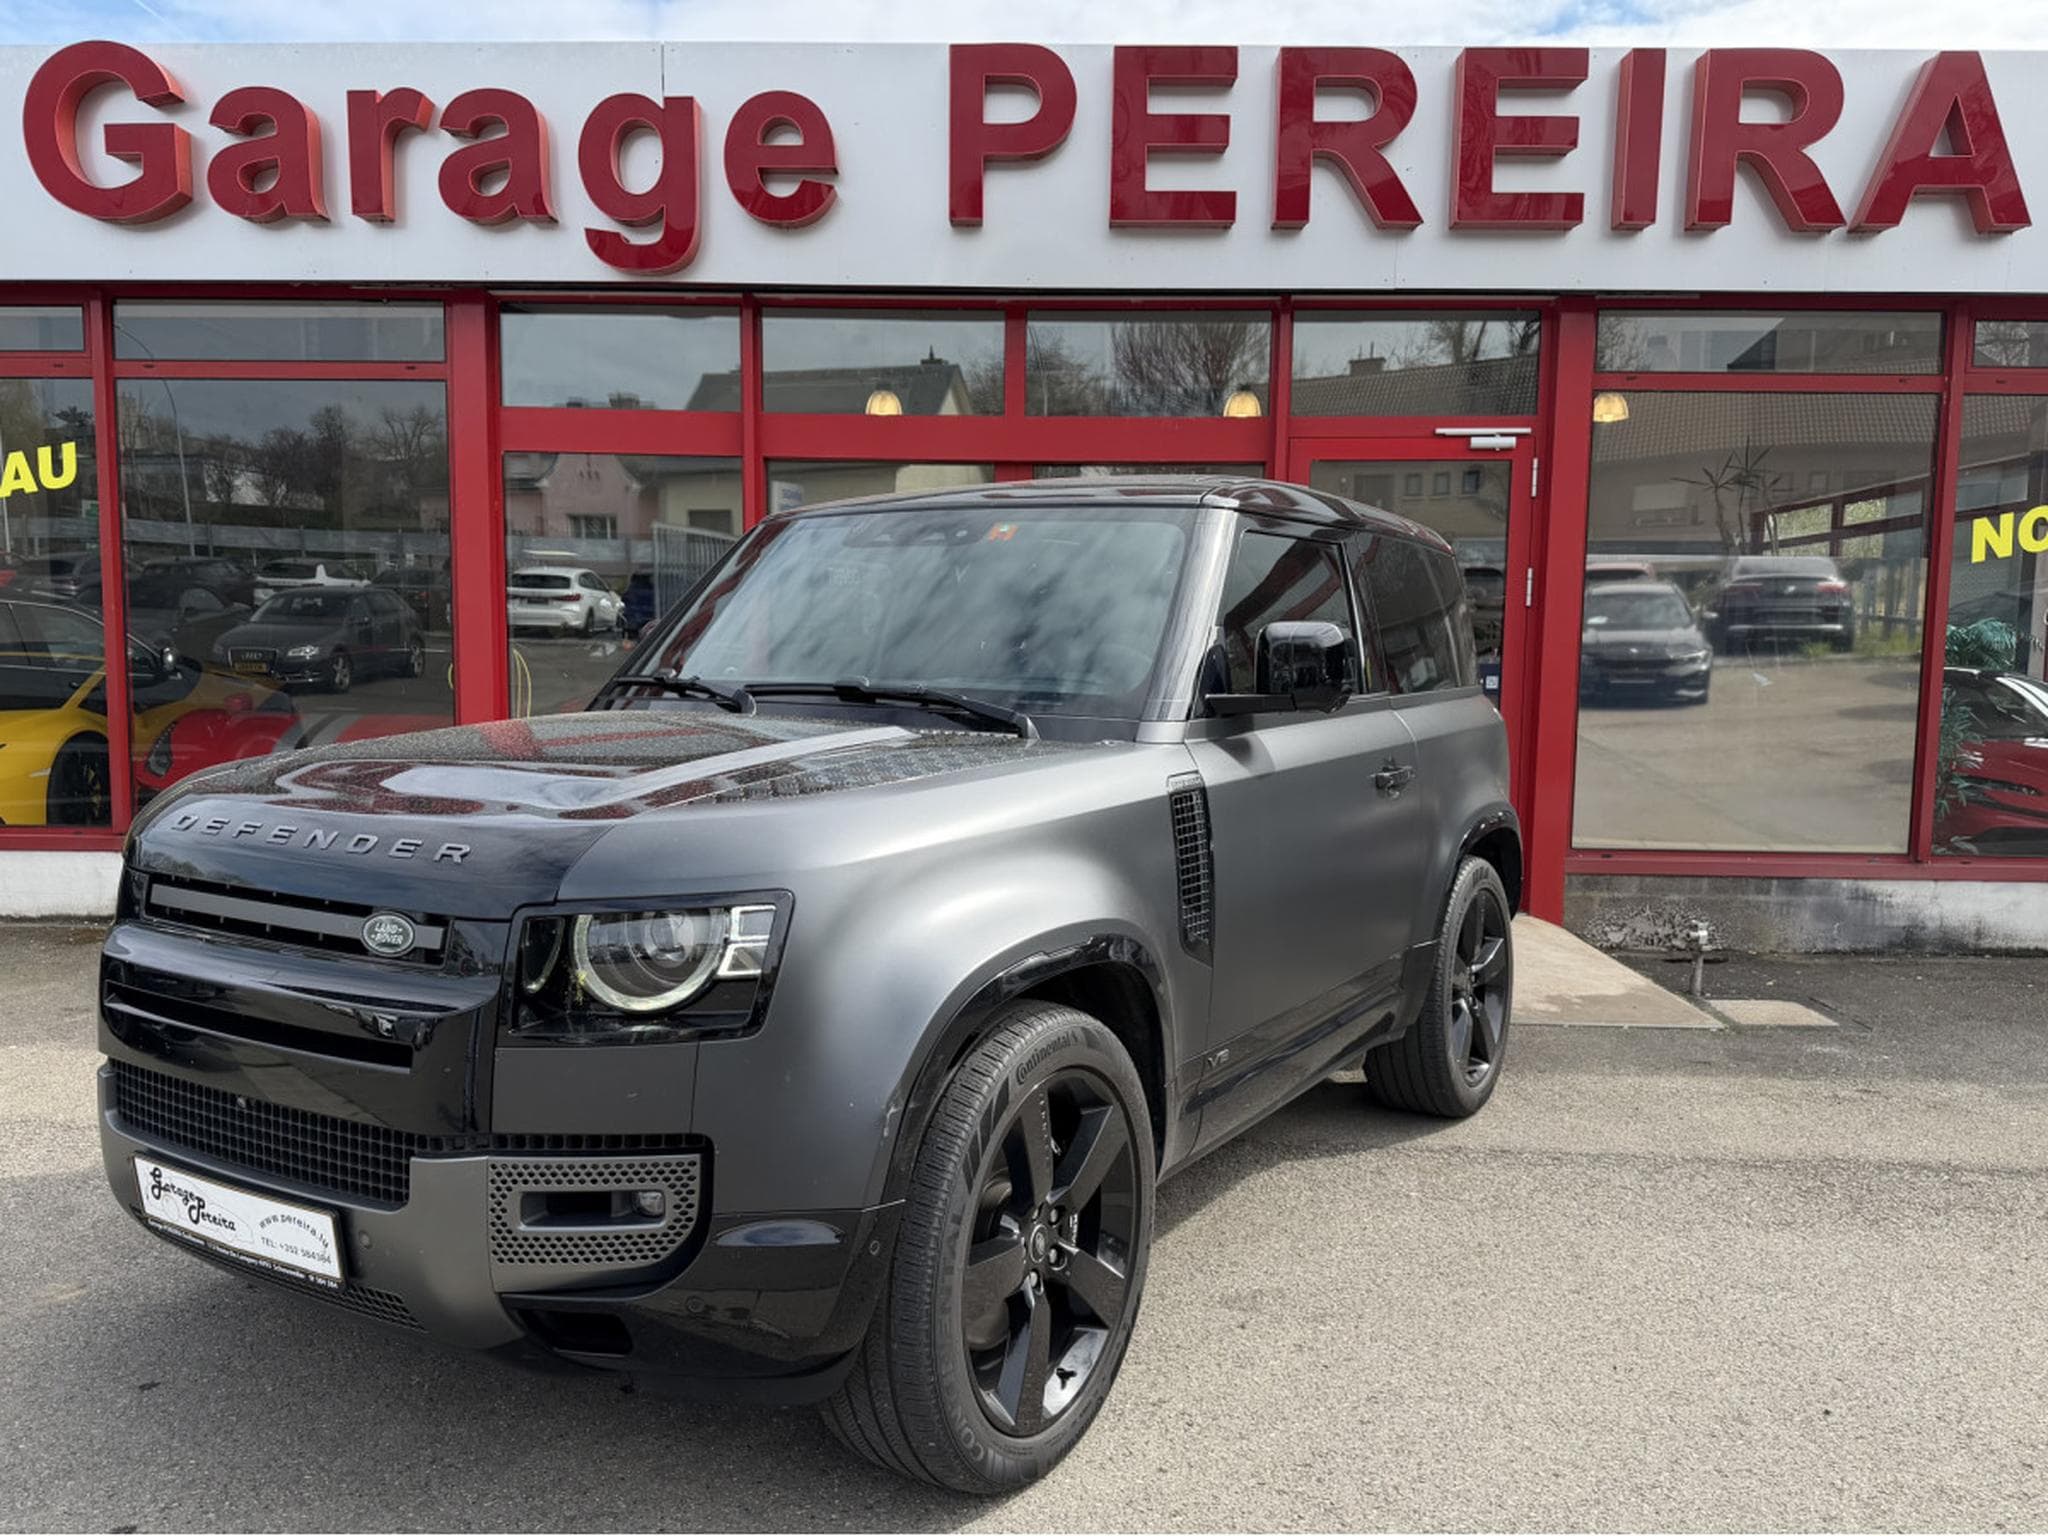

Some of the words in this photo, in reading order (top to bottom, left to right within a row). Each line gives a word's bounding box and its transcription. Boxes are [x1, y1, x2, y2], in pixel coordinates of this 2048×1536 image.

[23, 39, 839, 274] Garage
[949, 43, 2032, 235] PEREIRA
[0, 441, 77, 498] AU
[171, 814, 472, 865] DEFENDER
[1016, 1030, 1071, 1085] Continental
[150, 1167, 197, 1206] Garage
[188, 1196, 237, 1231] Pereira
